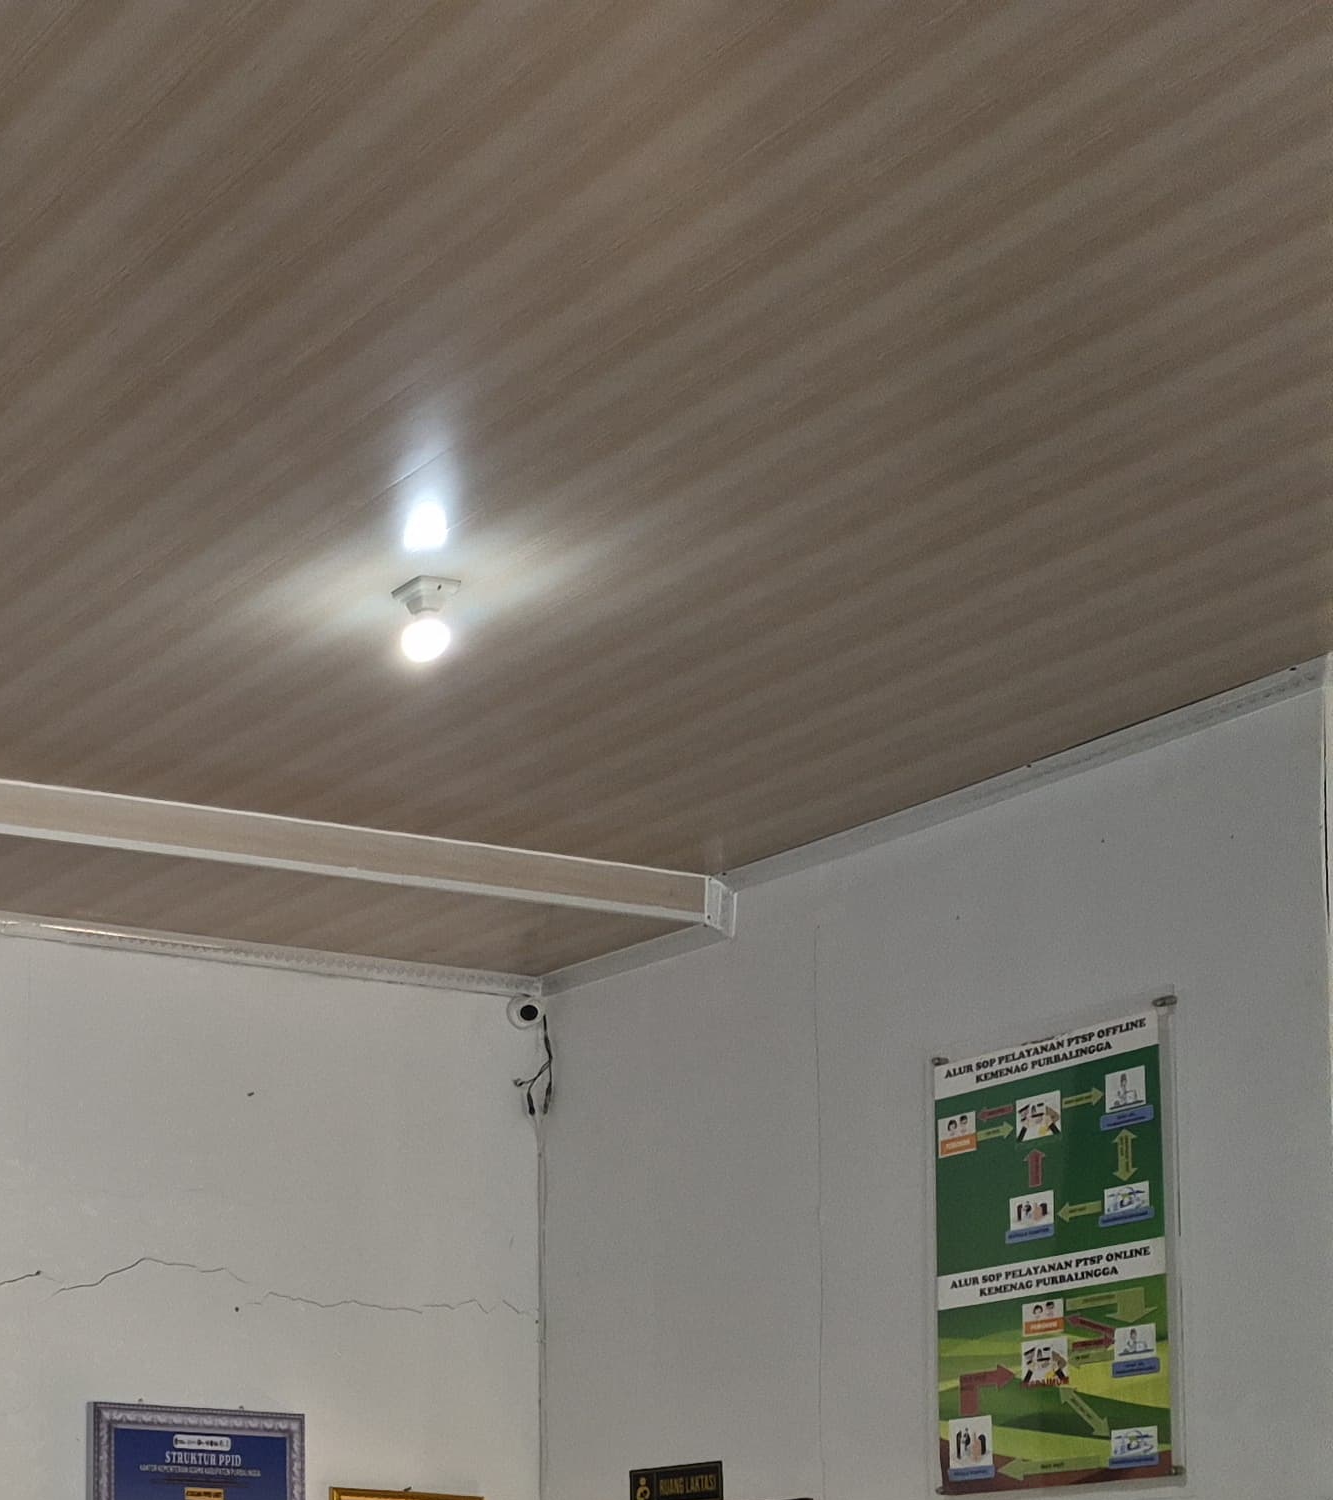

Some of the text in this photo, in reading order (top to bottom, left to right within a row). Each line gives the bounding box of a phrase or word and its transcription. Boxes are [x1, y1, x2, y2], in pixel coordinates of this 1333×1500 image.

[945, 1018, 1146, 1079] ALUR SOP PELAYANAN PTSP OFFLINE
[976, 1041, 1113, 1083] KEMENAG PURBALINGGA
[950, 1246, 1151, 1289] ALUR SOP PELAYANAN PTSP ONLINE
[979, 1265, 1119, 1297] KEMENAG PURBALINGGA
[165, 1450, 242, 1467] STRUKTUR PPID
[659, 1474, 718, 1496] RUANG LAKTASI
